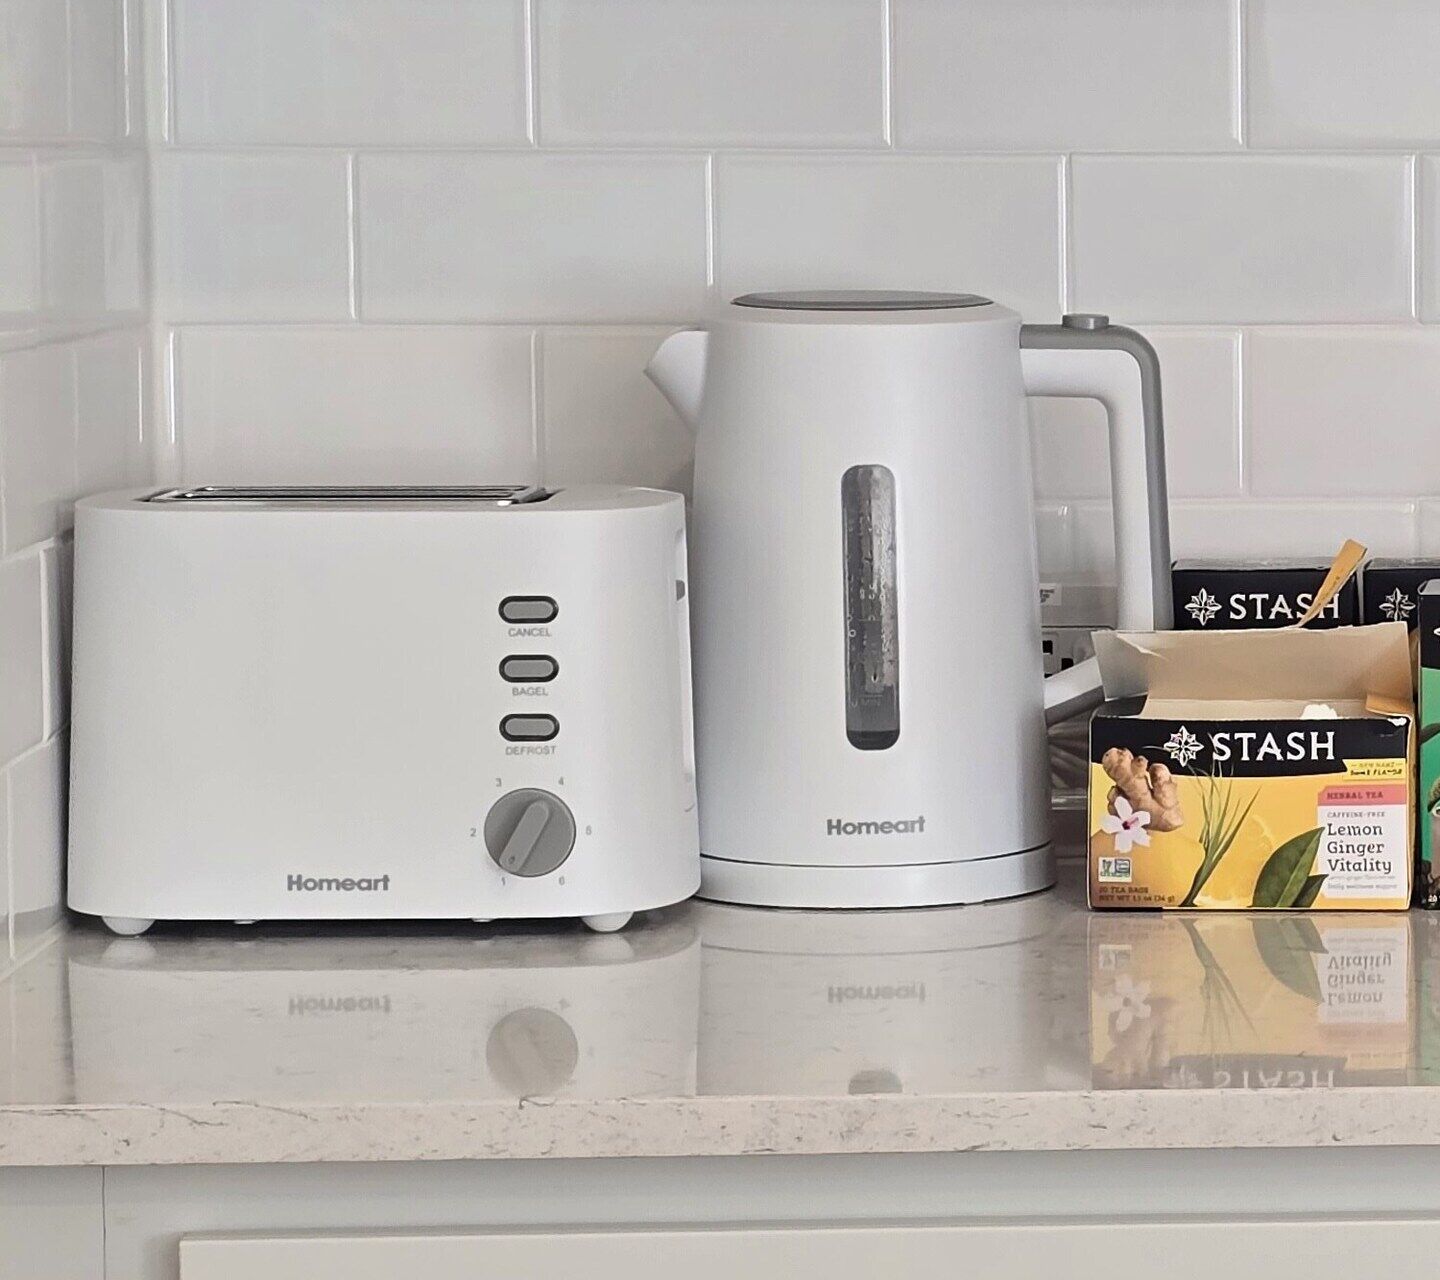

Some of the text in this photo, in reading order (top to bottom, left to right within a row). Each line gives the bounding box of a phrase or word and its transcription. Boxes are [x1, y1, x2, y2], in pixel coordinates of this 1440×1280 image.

[1229, 592, 1340, 620] STASH
[508, 628, 552, 637] CANCEL
[512, 687, 549, 696] BAGEL
[505, 746, 556, 756] DEFROST
[1212, 732, 1335, 761] STASH
[558, 777, 564, 785] 4
[470, 828, 477, 837] 2
[826, 815, 926, 836] Homeart
[1327, 823, 1383, 836] Lemon
[1327, 840, 1385, 857] Ginger
[1327, 858, 1392, 875] Vitality
[287, 874, 390, 891] Homeart
